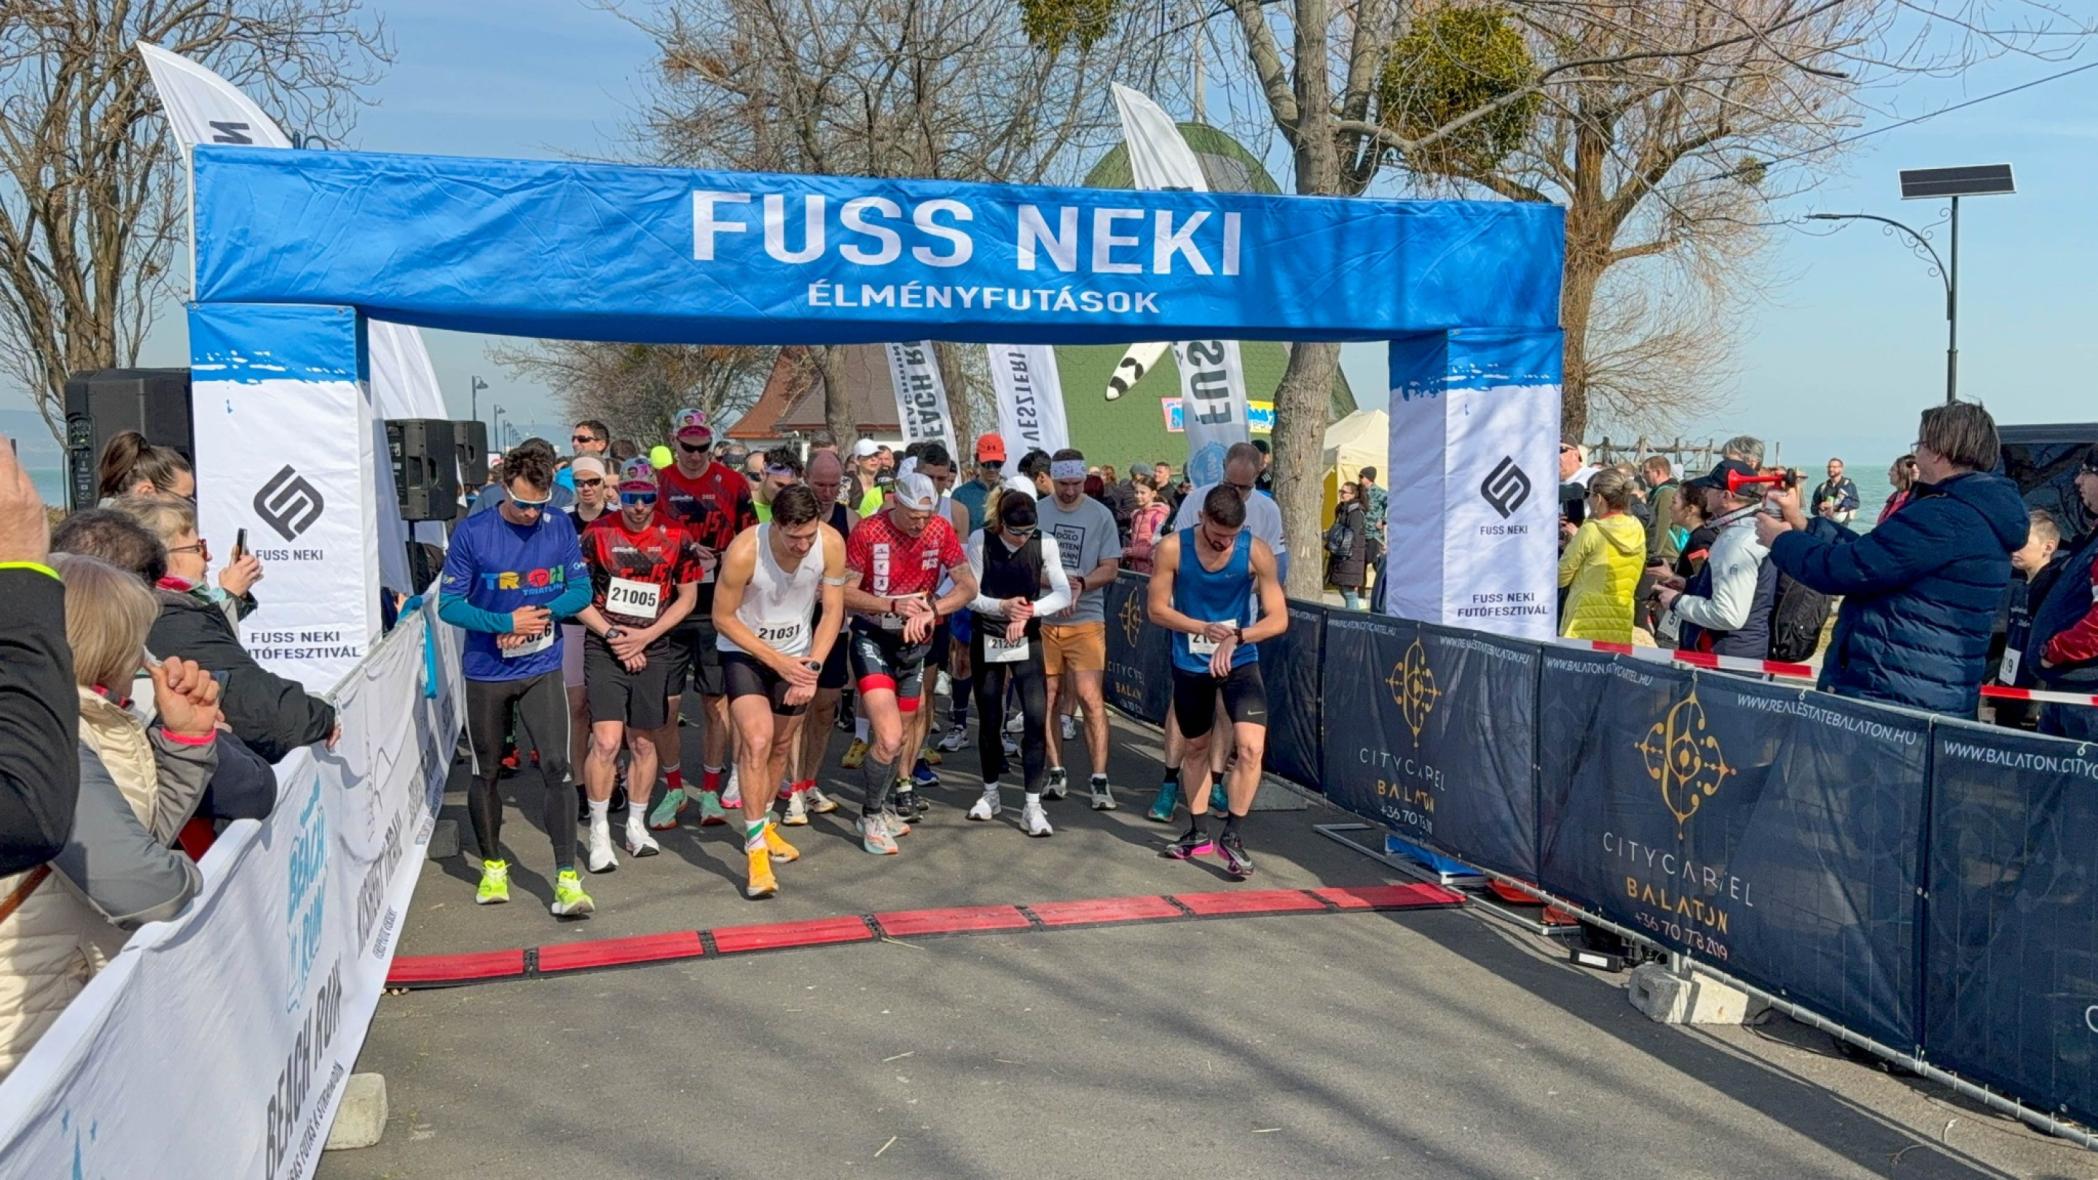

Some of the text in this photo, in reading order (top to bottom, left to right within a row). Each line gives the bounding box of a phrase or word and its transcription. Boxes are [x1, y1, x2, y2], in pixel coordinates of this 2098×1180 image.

[692, 190, 1241, 276] FUSS NEKI
[808, 279, 1160, 314] ÉLMÉNYFUTÁSOK
[1480, 525, 1528, 535] FUSS NEKI
[255, 549, 323, 561] FUSS NEKI
[611, 587, 656, 607] 21005
[1472, 592, 1535, 604] FUSS NEKI
[1457, 603, 1549, 618] FUTÓFESZTIVÁL
[251, 631, 340, 643] FUSS NEKI
[758, 624, 800, 640] 21031
[1737, 693, 1917, 745] WWW.REALESTATEBALATON.HU
[1661, 920, 1681, 941] 70
[266, 951, 342, 1180] BEACH RUN
